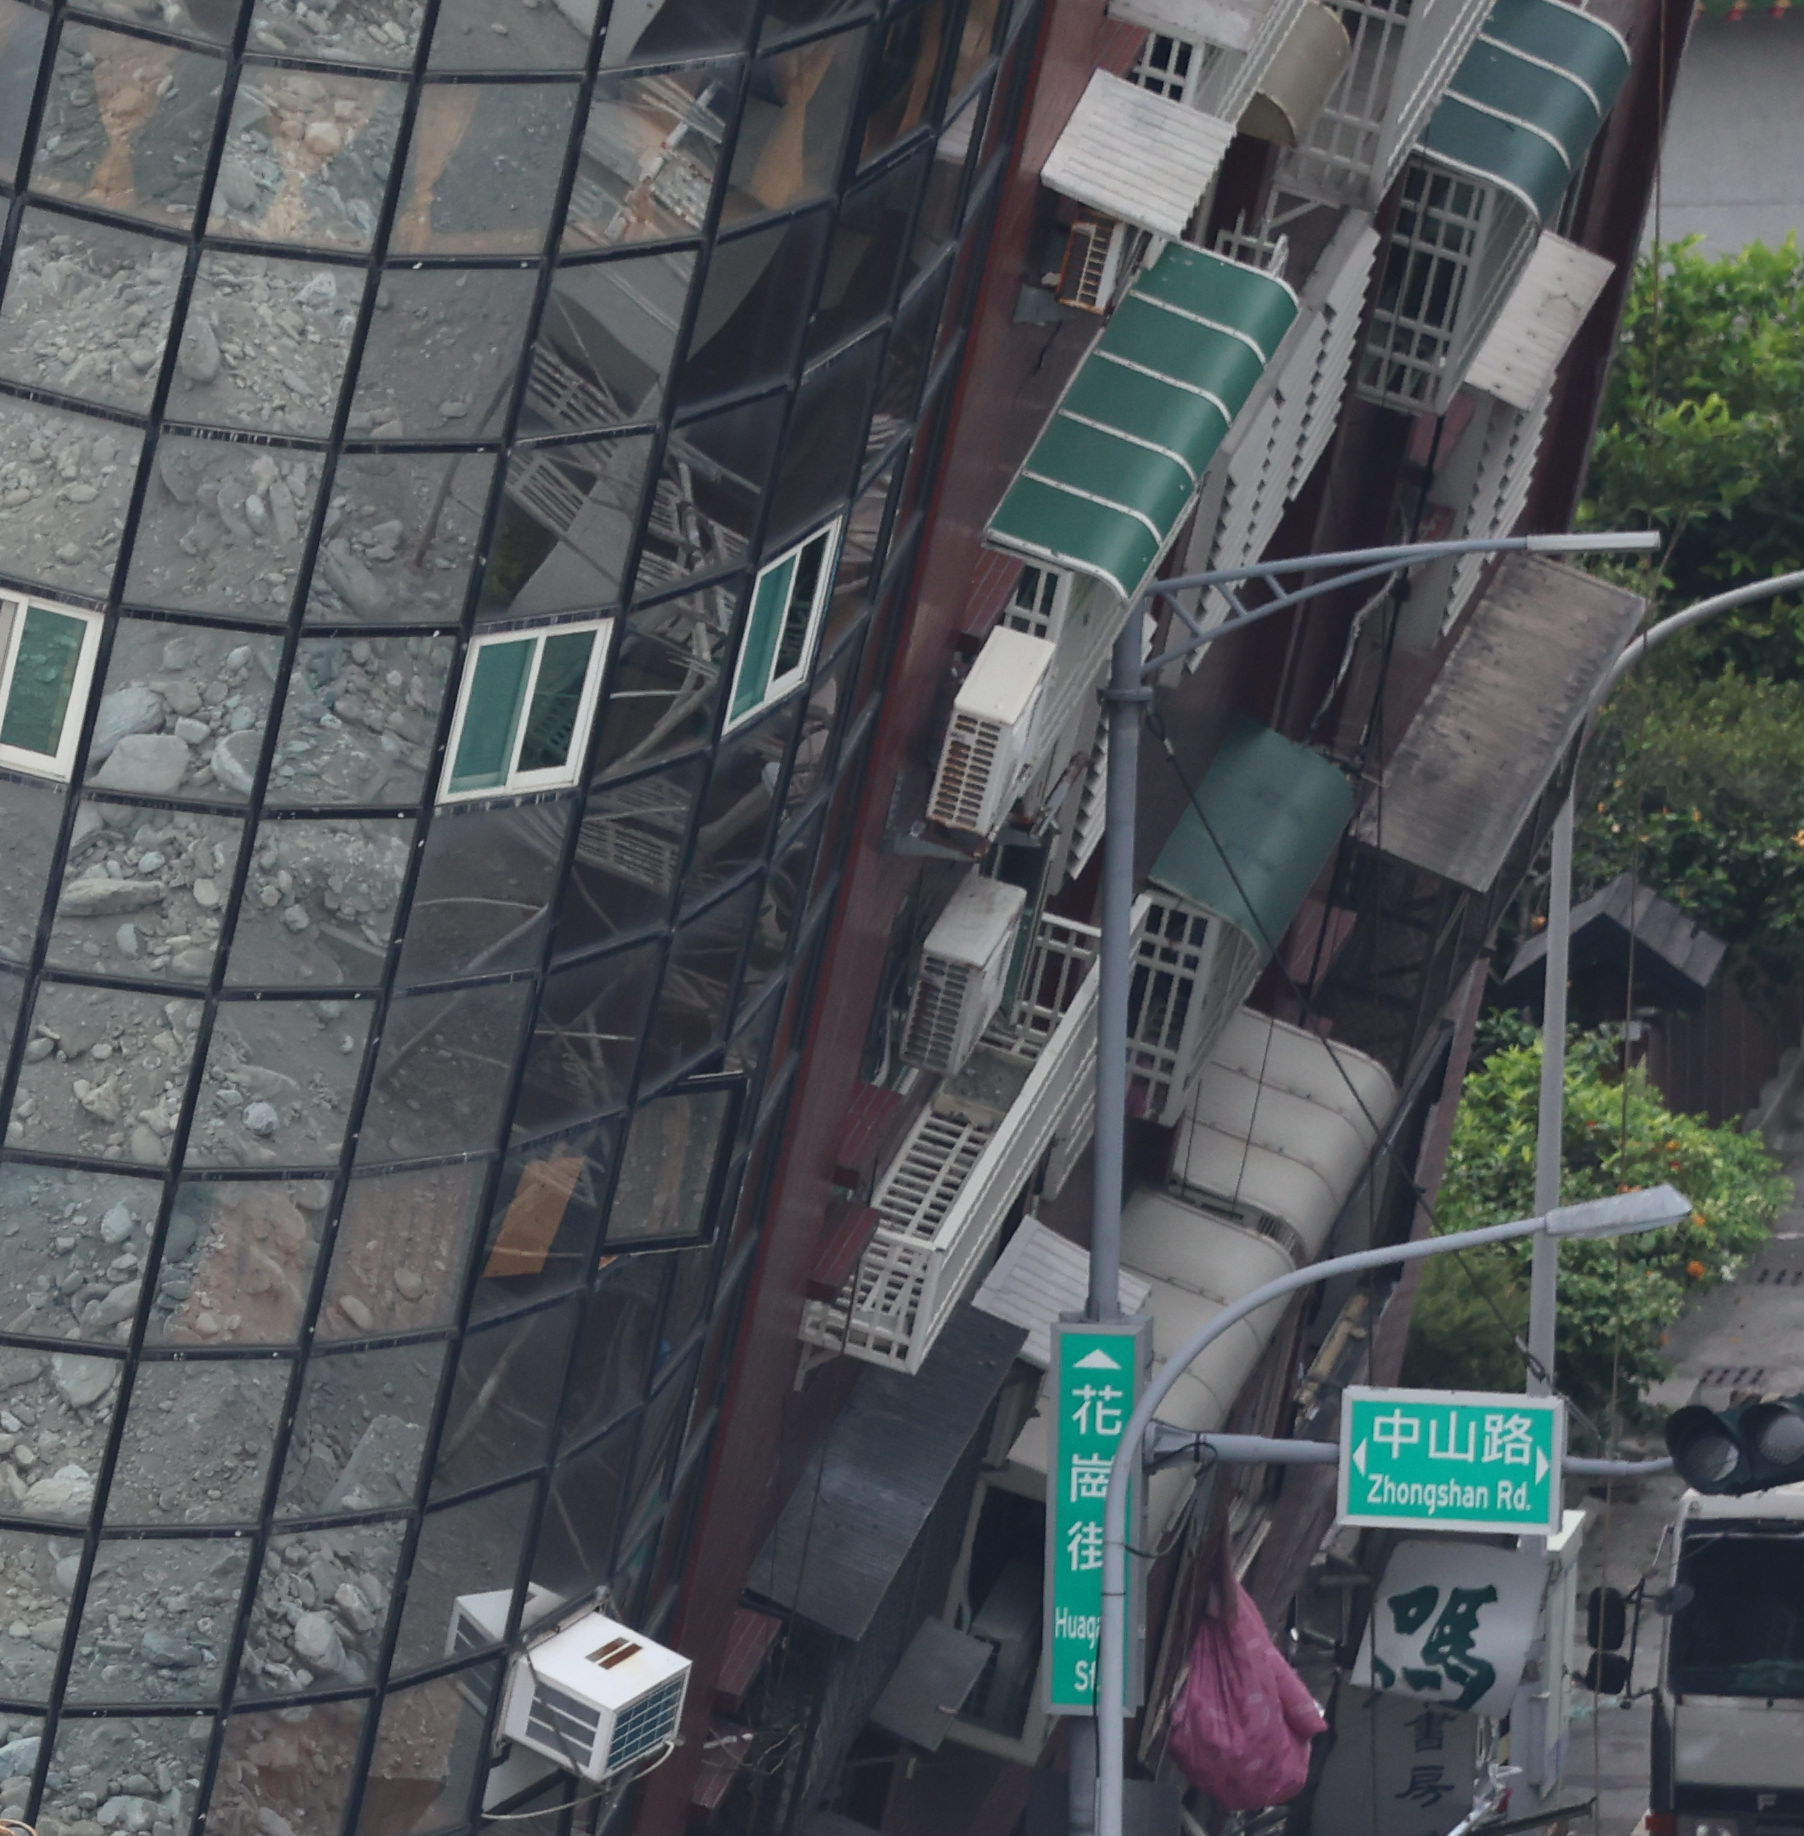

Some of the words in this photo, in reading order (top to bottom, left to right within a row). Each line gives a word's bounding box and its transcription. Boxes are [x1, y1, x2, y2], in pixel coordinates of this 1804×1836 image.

[1372, 1408, 1533, 1466] 中山路
[1366, 1473, 1489, 1516] Zhongshan
[1496, 1479, 1532, 1512] Rd.
[1055, 1606, 1102, 1650] Huag
